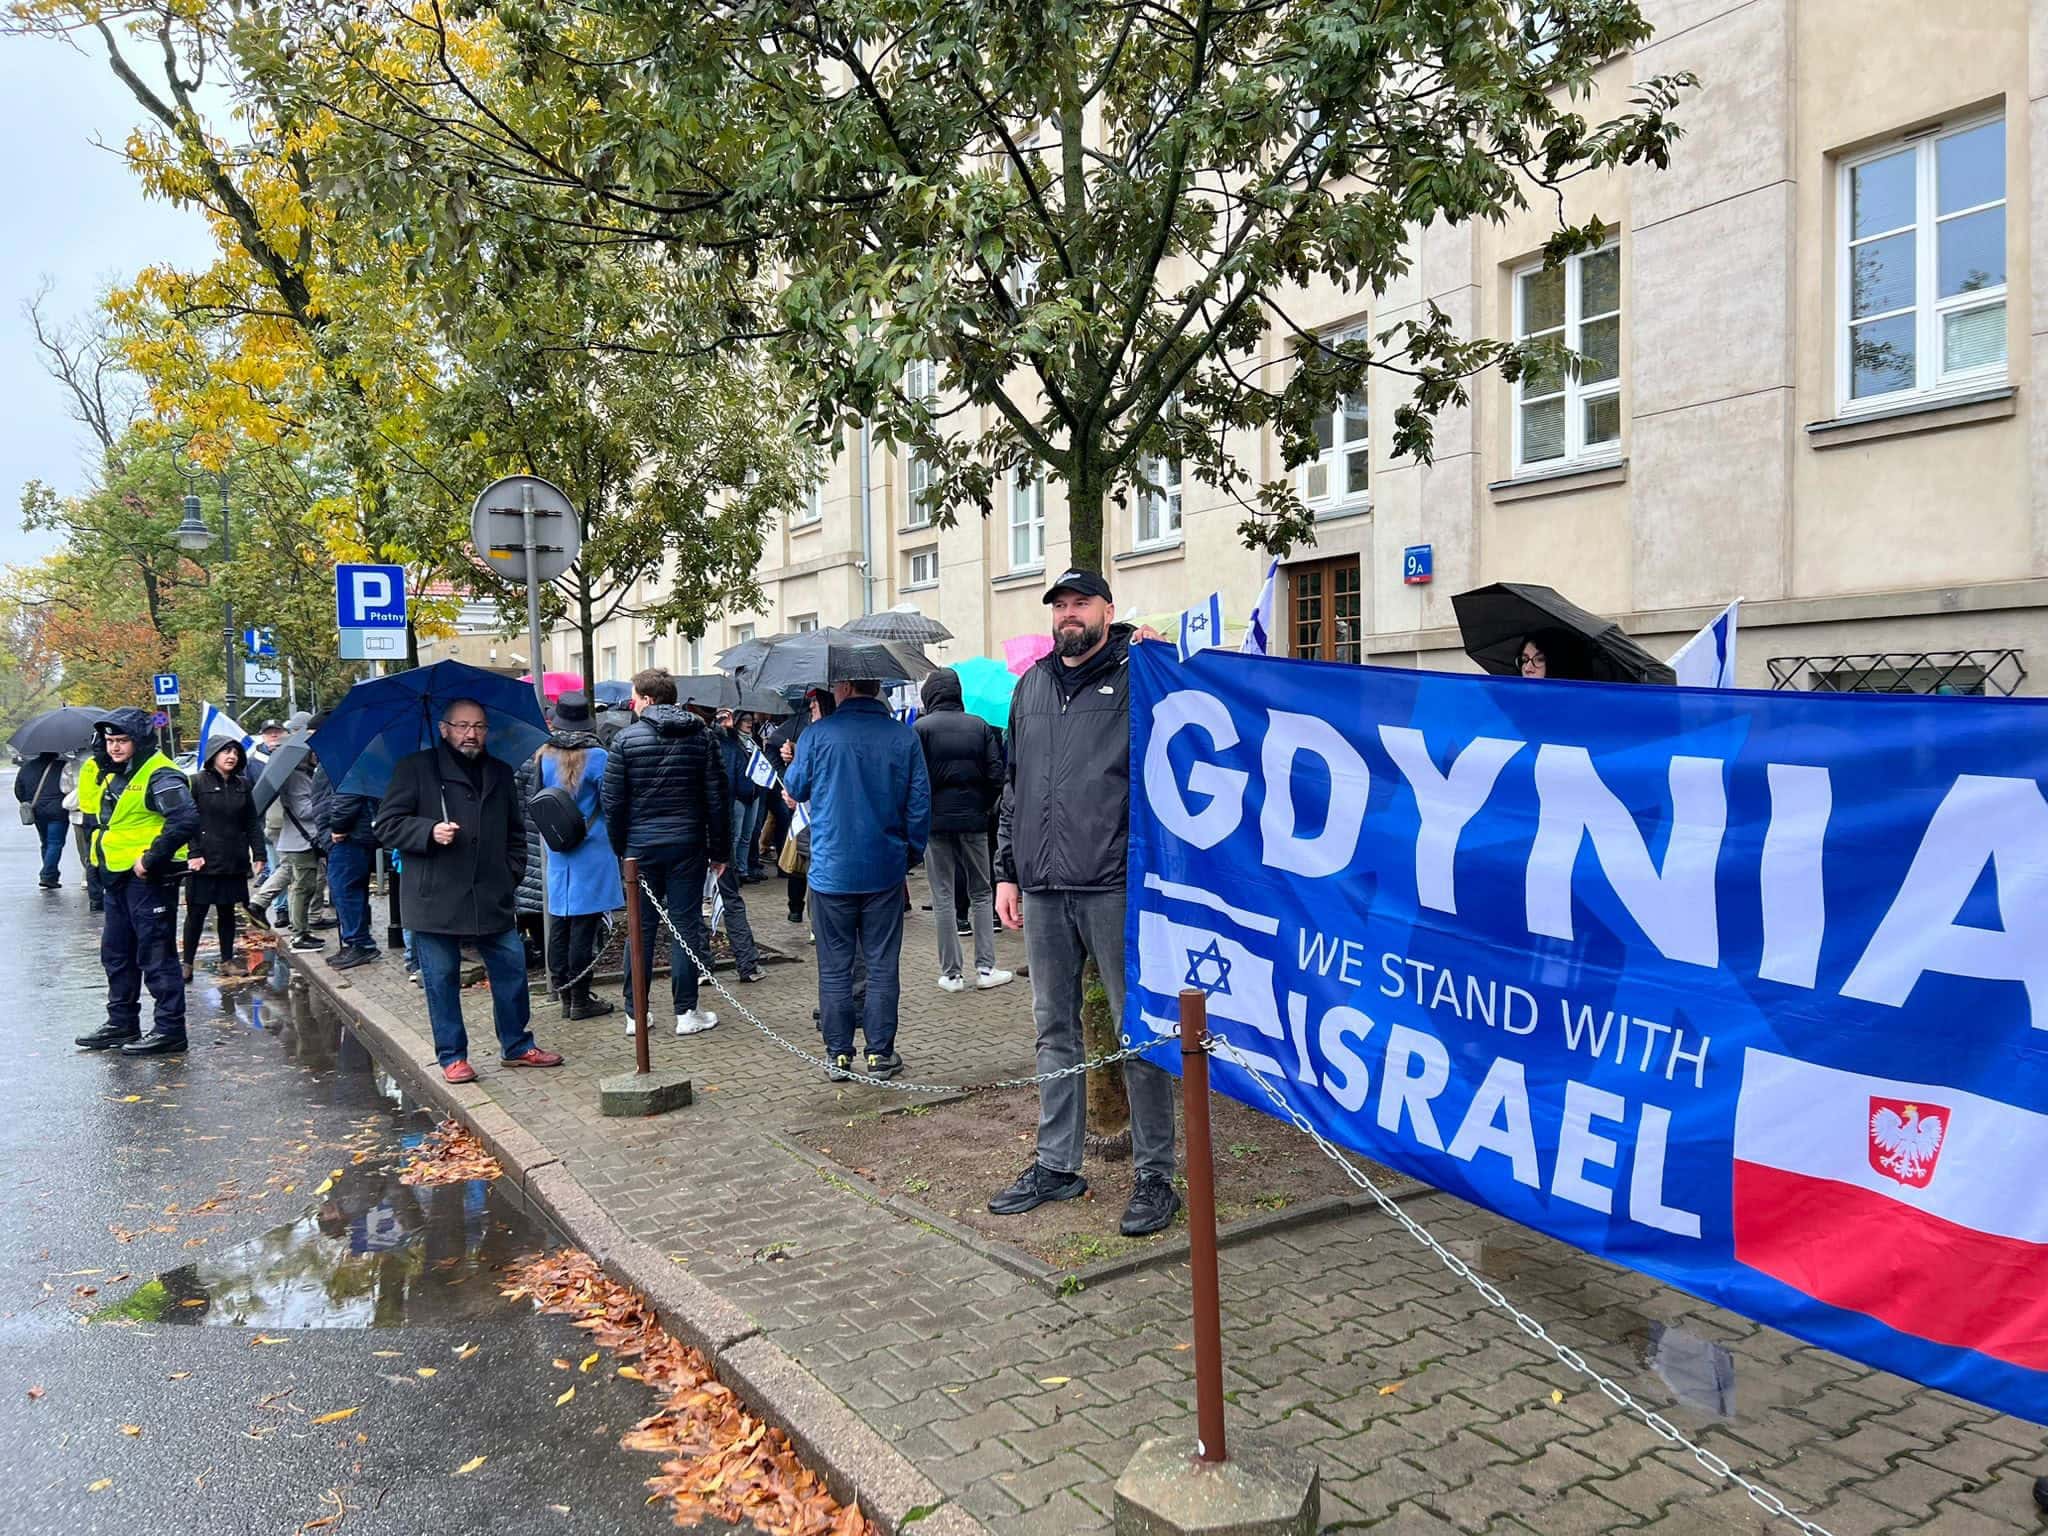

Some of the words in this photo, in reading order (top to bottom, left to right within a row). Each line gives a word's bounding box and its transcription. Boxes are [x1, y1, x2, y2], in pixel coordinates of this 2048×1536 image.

[352, 571, 392, 621] P
[159, 676, 174, 693] P
[1143, 689, 2048, 1031] GDYNIA
[1298, 927, 1364, 987] WE
[1380, 952, 1539, 1036] STAND
[1561, 999, 1711, 1089] WITH
[1287, 990, 1702, 1240] ISRAEL
